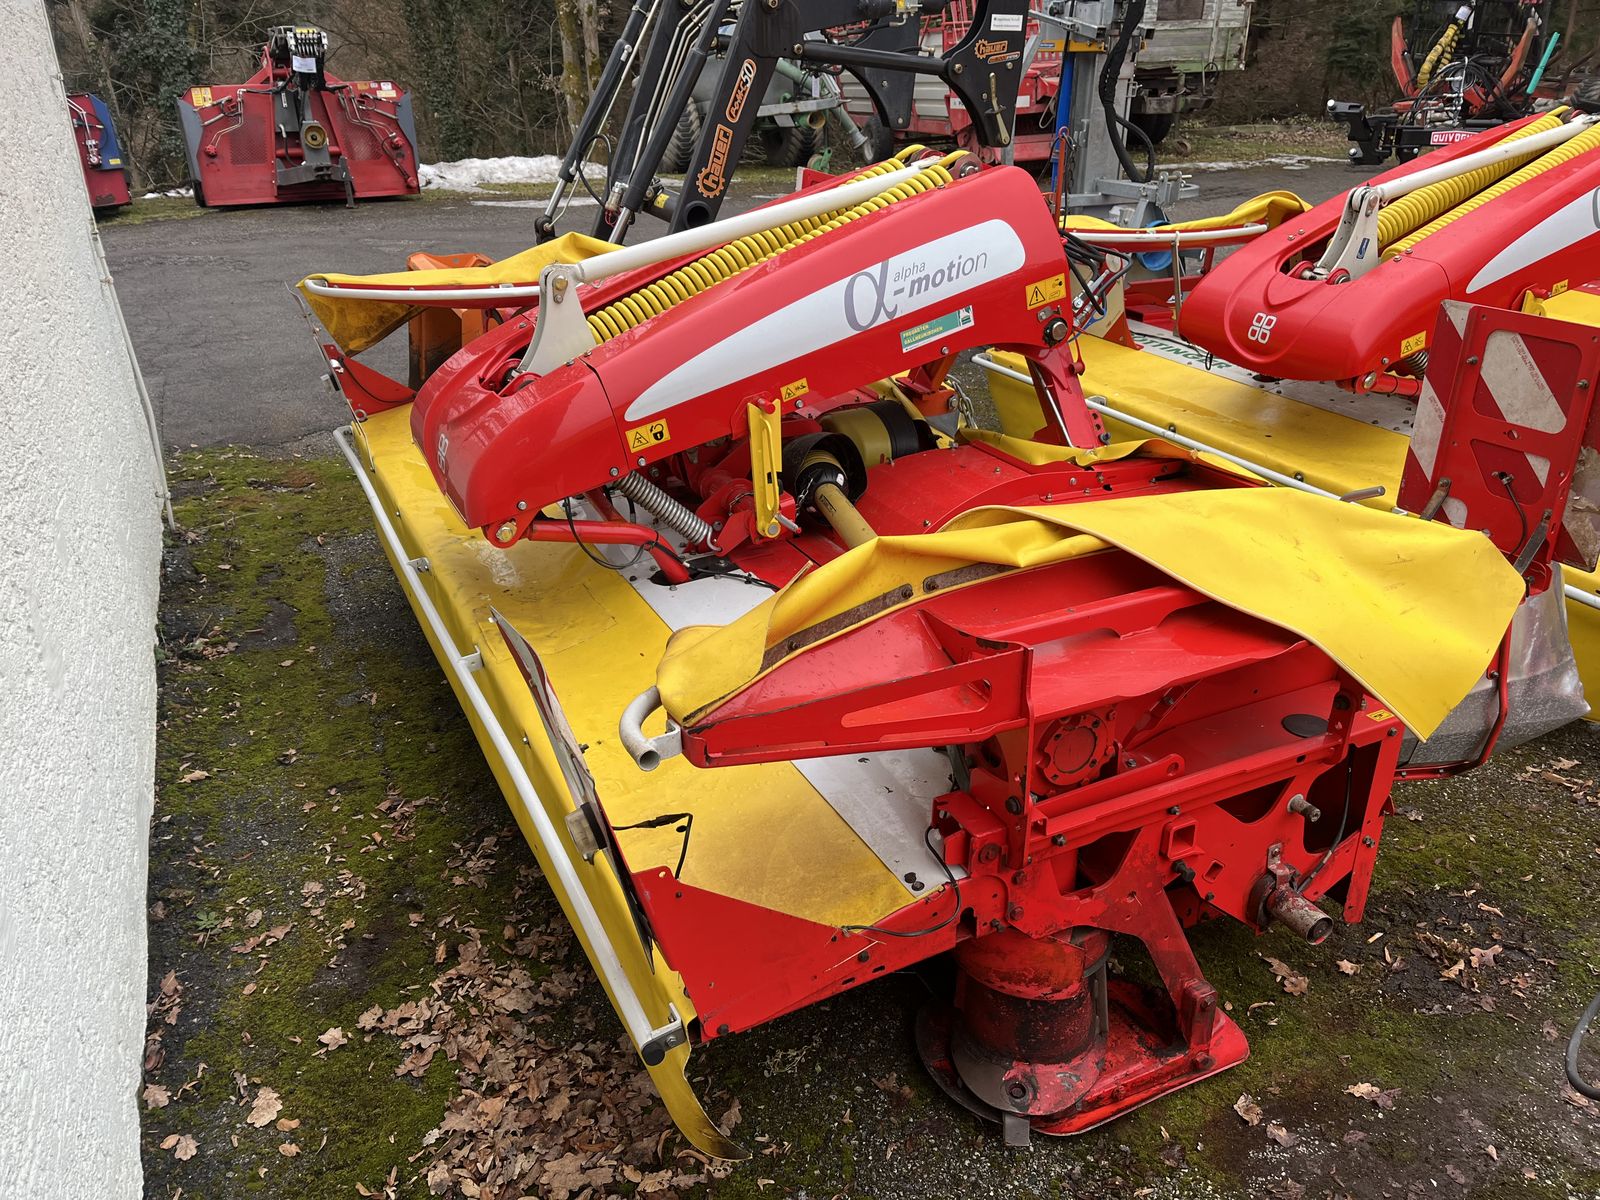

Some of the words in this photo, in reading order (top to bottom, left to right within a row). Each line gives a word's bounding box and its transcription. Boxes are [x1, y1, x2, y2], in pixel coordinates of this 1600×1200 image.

[980, 42, 1007, 55] hauer
[742, 62, 754, 88] 50
[1433, 133, 1473, 143] QUIVOG
[703, 129, 730, 190] hauer
[893, 261, 926, 283] alpha
